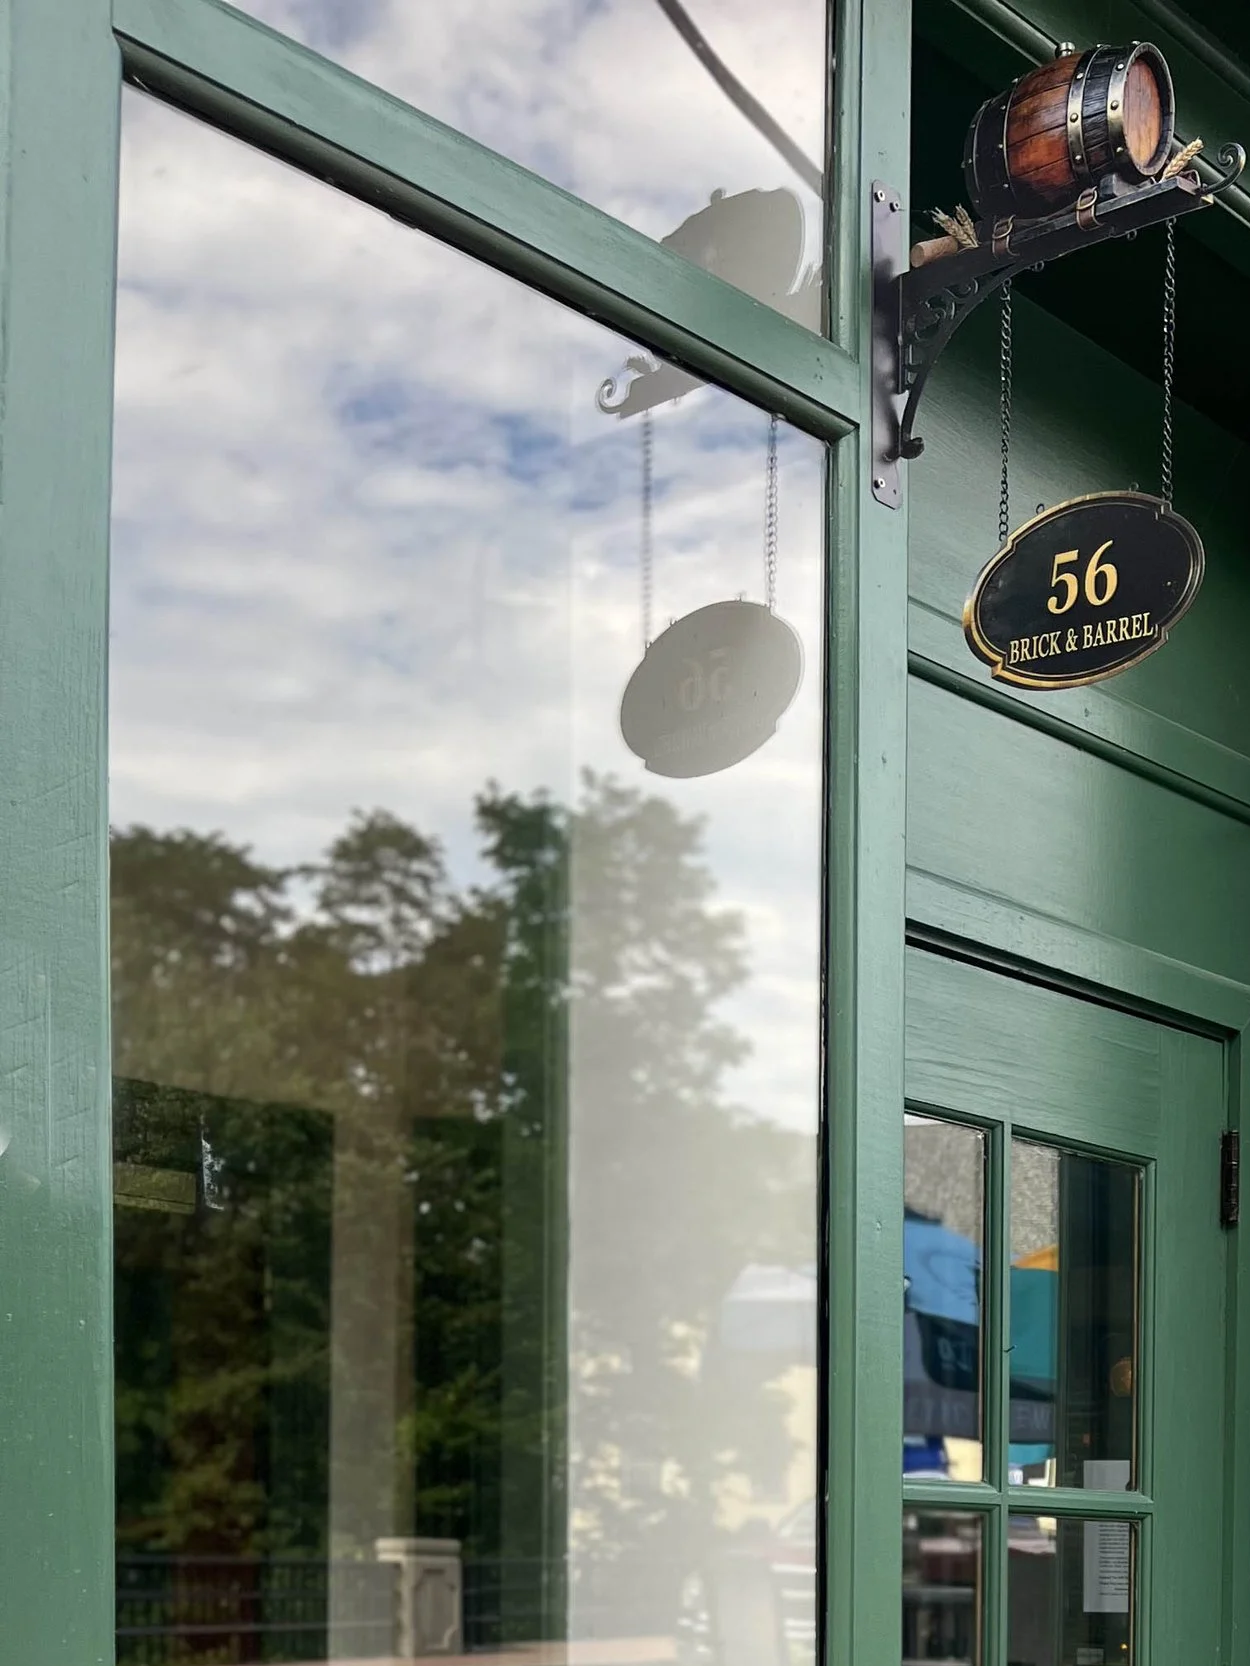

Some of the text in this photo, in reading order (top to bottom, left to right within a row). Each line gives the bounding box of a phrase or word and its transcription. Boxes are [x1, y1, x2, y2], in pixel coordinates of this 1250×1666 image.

[1046, 539, 1118, 615] 56
[1009, 612, 1155, 664] BRICK & BARREL
